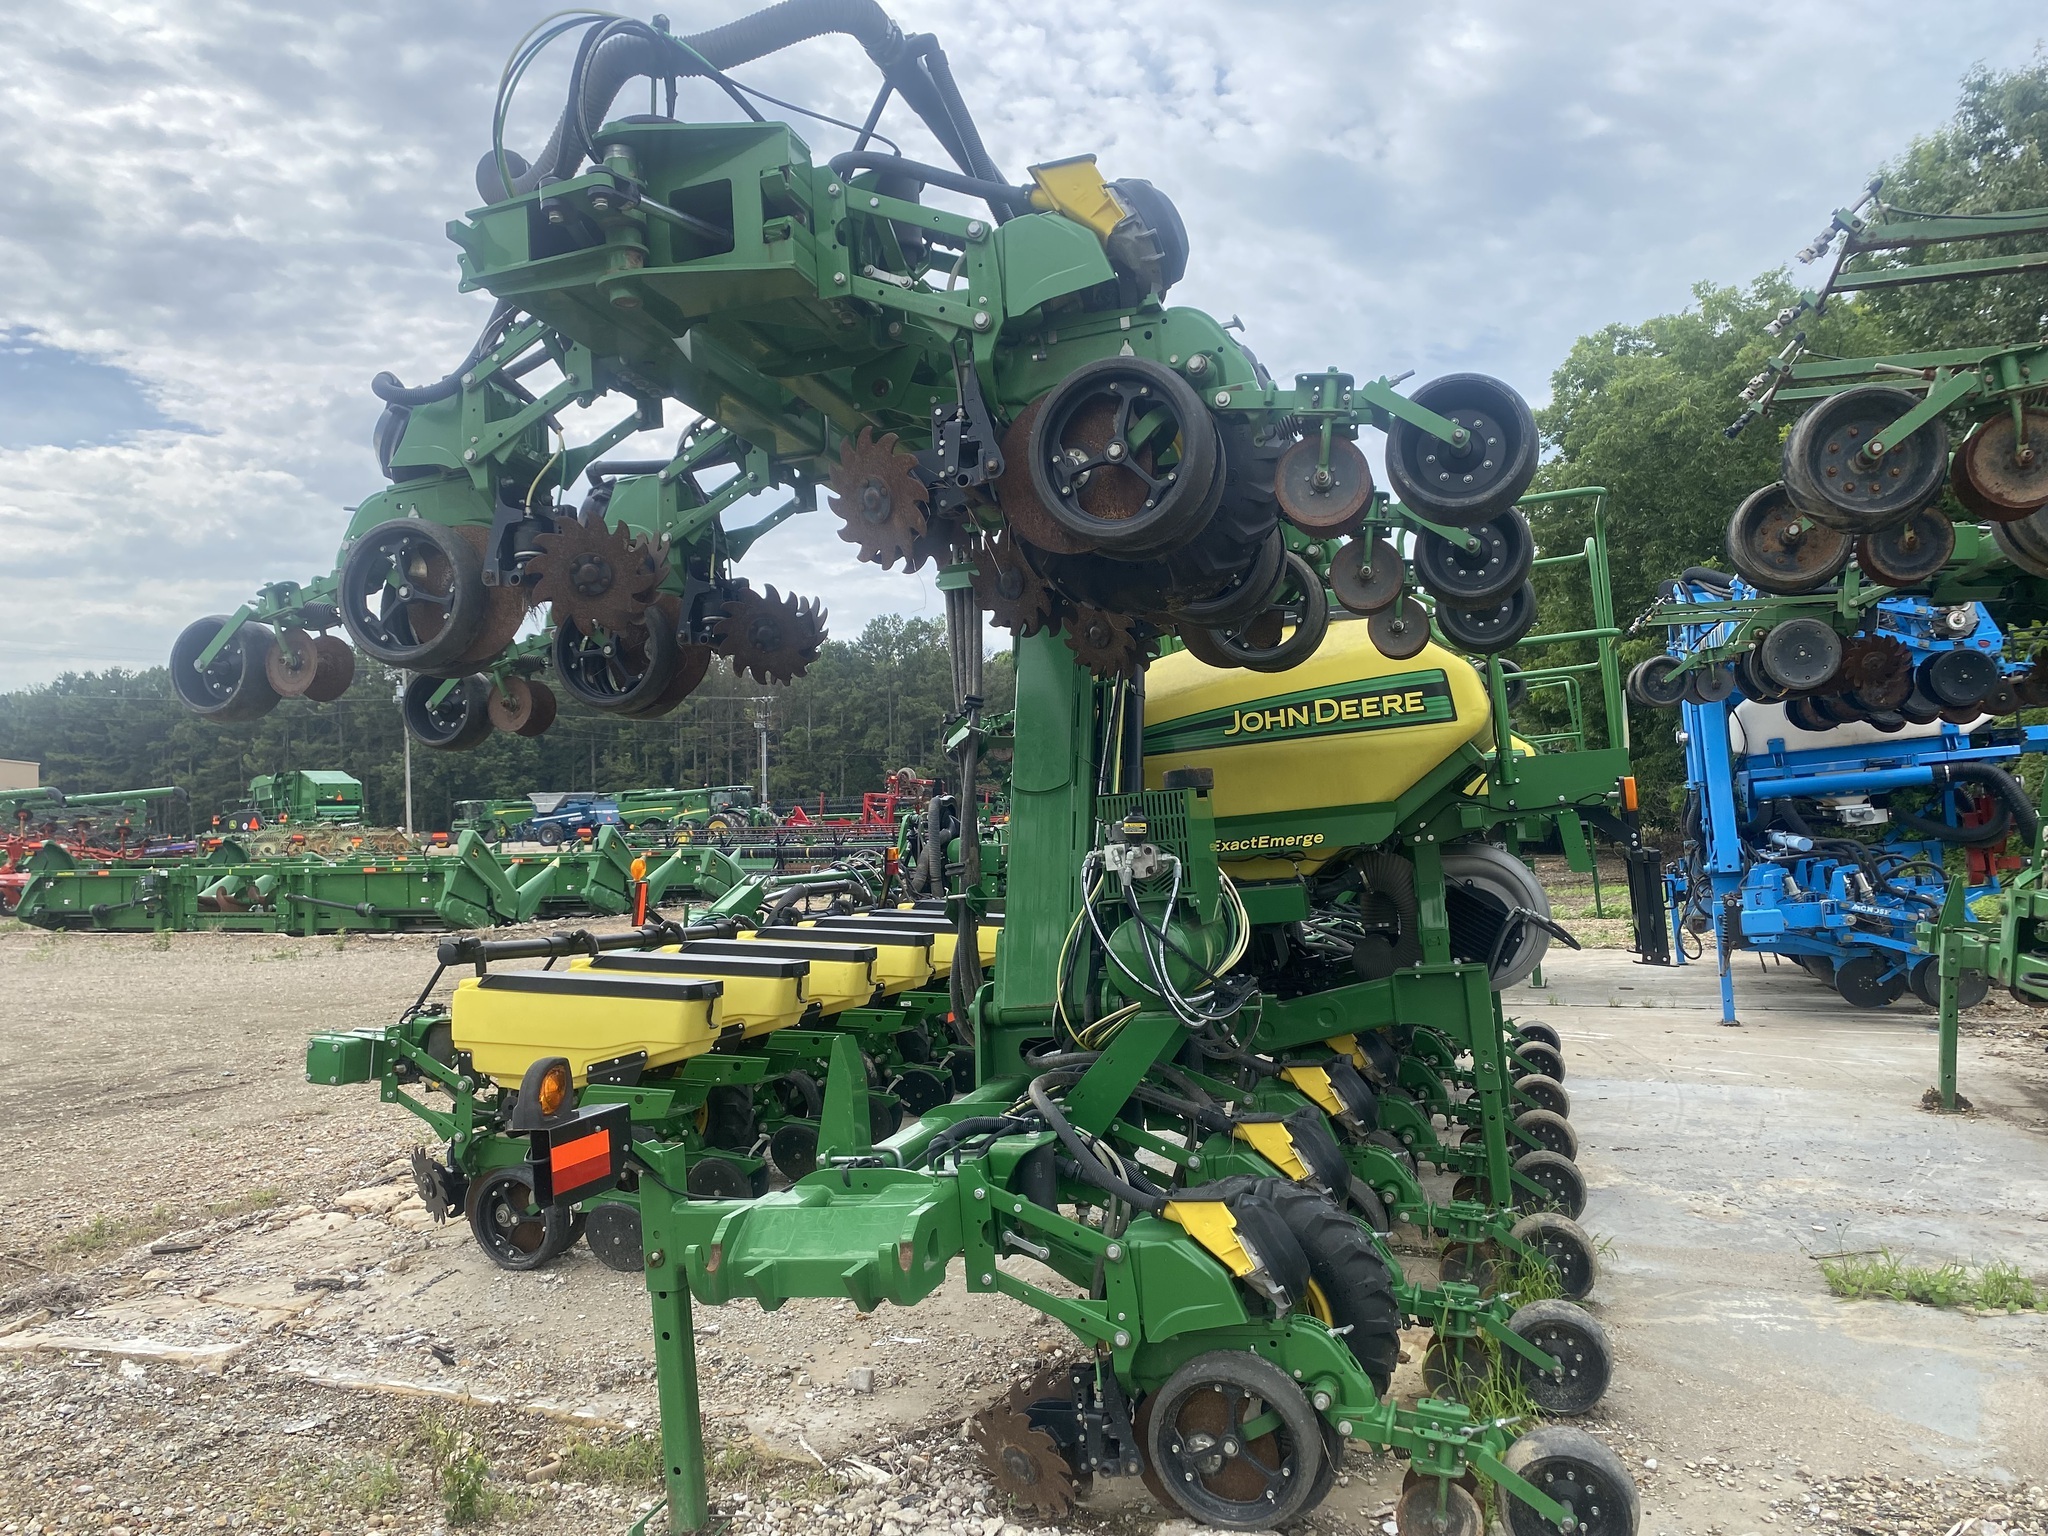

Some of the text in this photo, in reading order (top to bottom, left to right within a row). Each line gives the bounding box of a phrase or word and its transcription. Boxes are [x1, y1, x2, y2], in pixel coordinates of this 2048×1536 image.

[1224, 691, 1427, 736] JOHN DEERE
[1215, 832, 1325, 852] ExactEmerge
